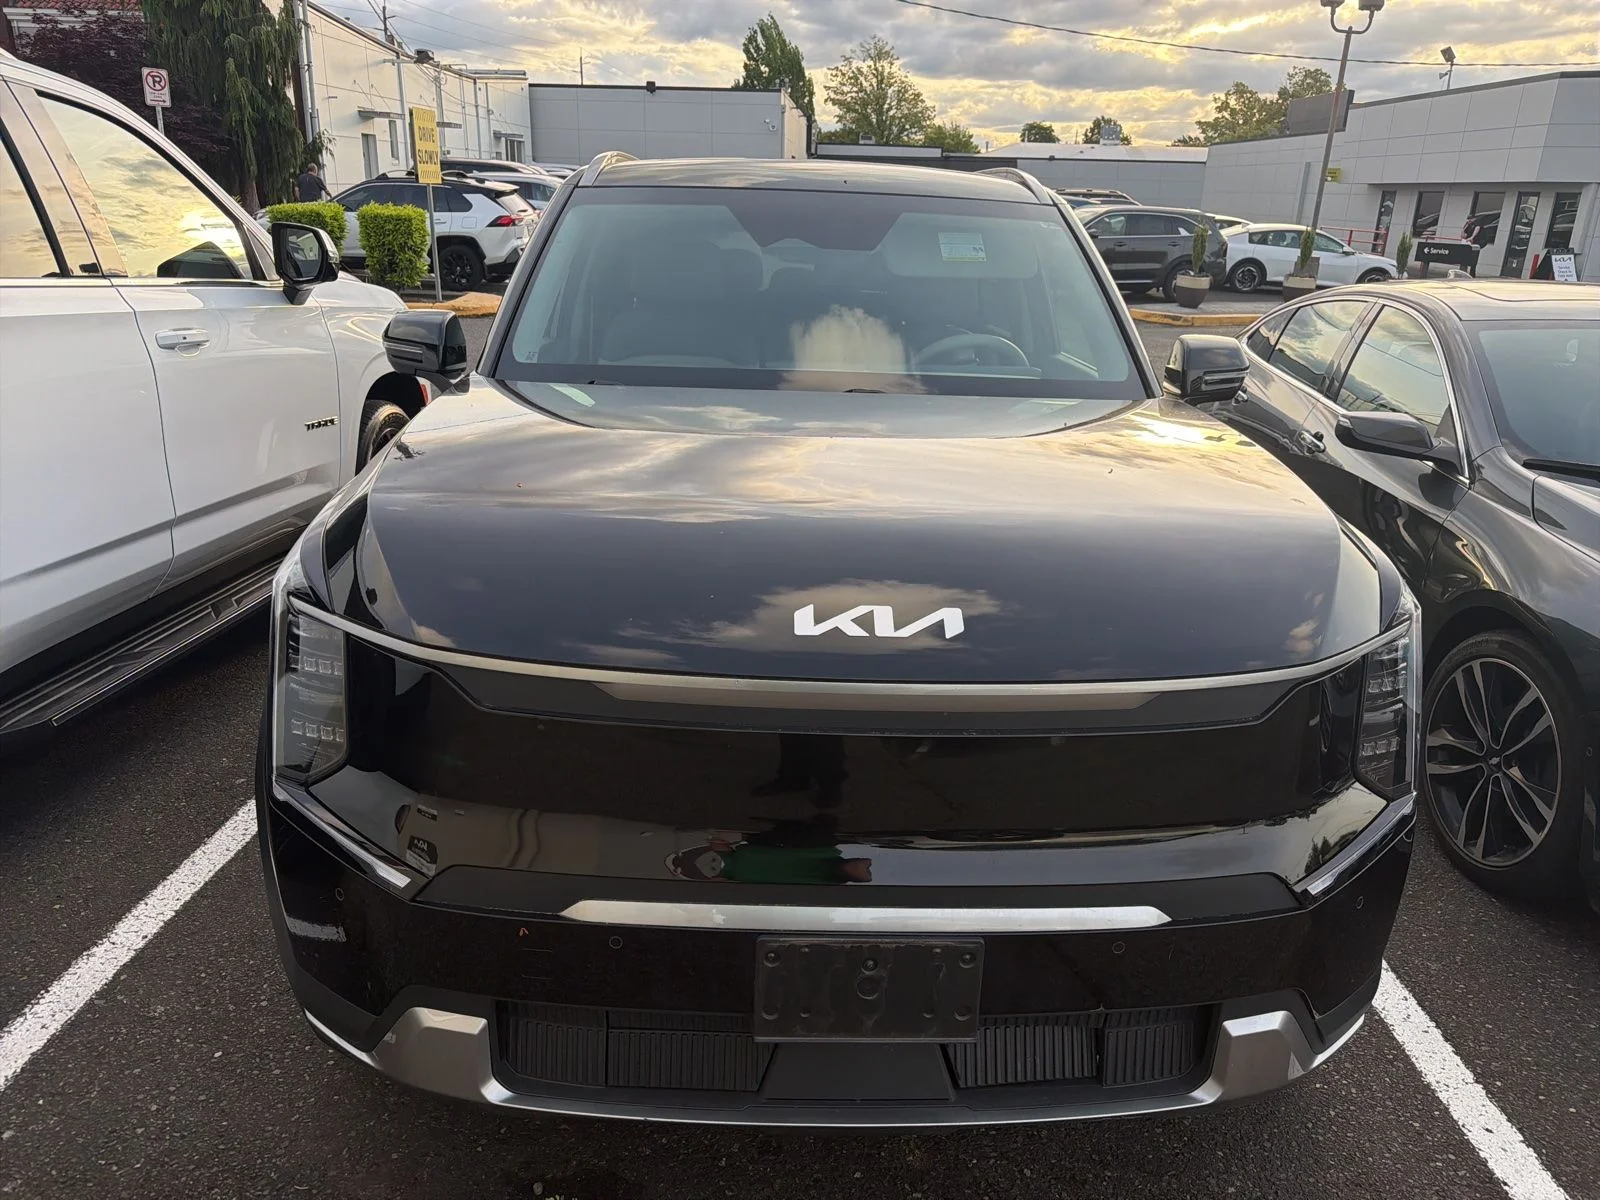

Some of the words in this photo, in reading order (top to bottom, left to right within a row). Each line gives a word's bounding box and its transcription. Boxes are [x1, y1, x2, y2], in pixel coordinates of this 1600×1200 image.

[418, 125, 435, 143] DRIVE
[417, 148, 439, 166] SLOWLY
[1430, 247, 1450, 255] Service
[794, 603, 965, 639] KIA
